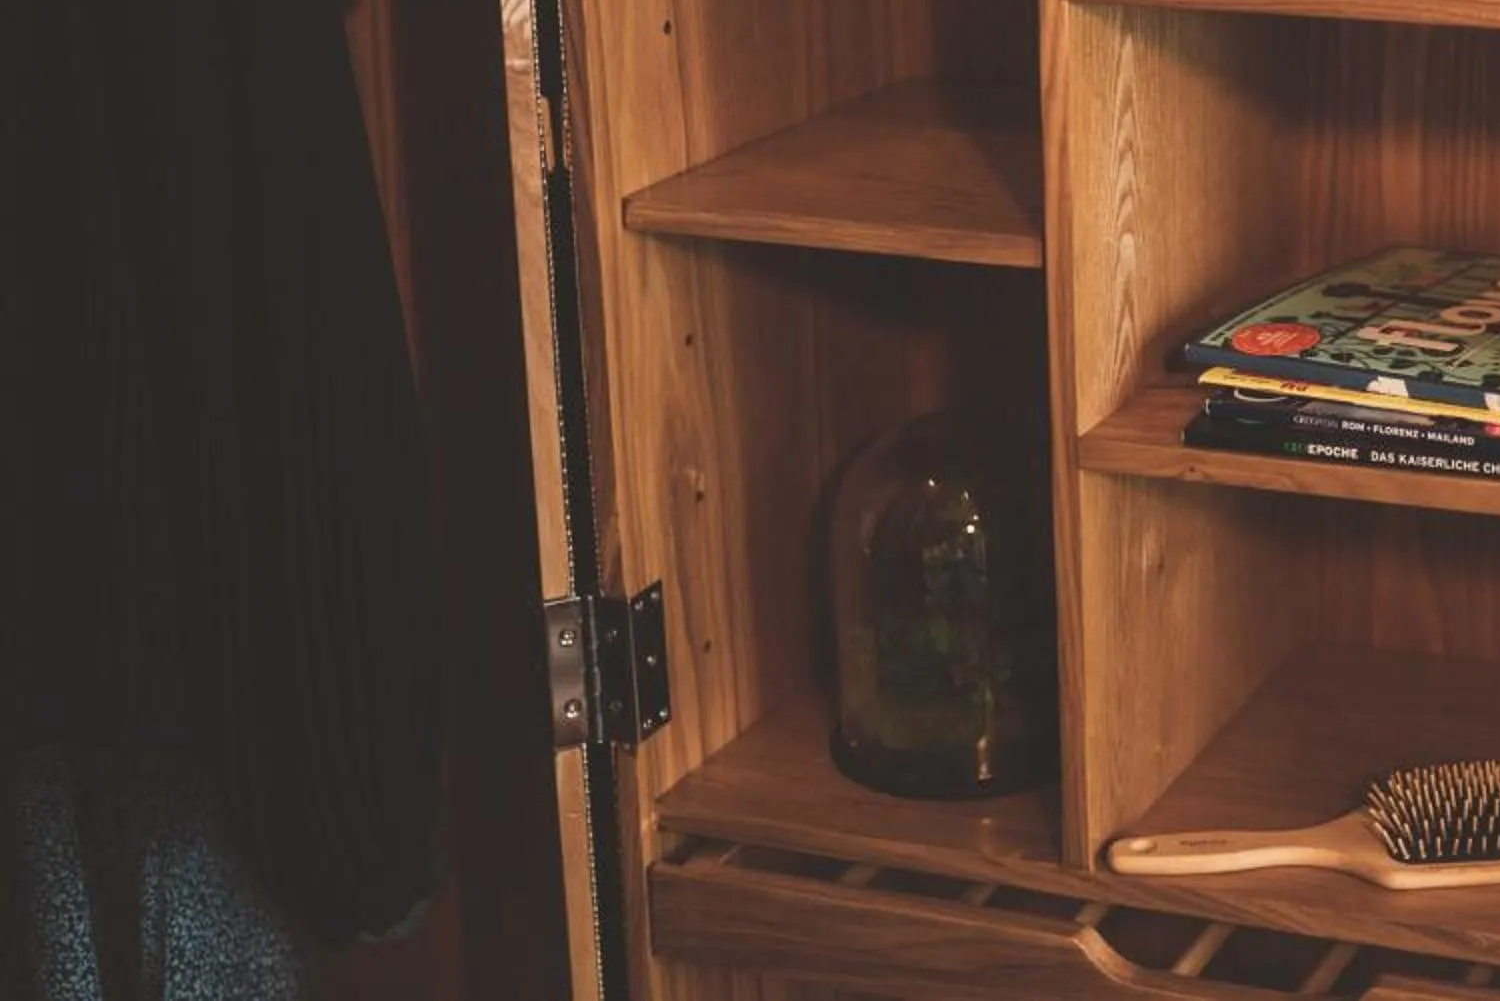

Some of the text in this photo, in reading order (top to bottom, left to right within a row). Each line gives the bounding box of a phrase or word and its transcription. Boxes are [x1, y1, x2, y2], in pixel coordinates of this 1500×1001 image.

[1341, 420, 1365, 432] ROM
[1373, 424, 1419, 439] FLORENZ
[1427, 431, 1475, 446] MAILAND
[1307, 443, 1359, 459] EPOCHE
[1370, 450, 1396, 464] DAS
[1399, 454, 1480, 472] KAISERLICHE
